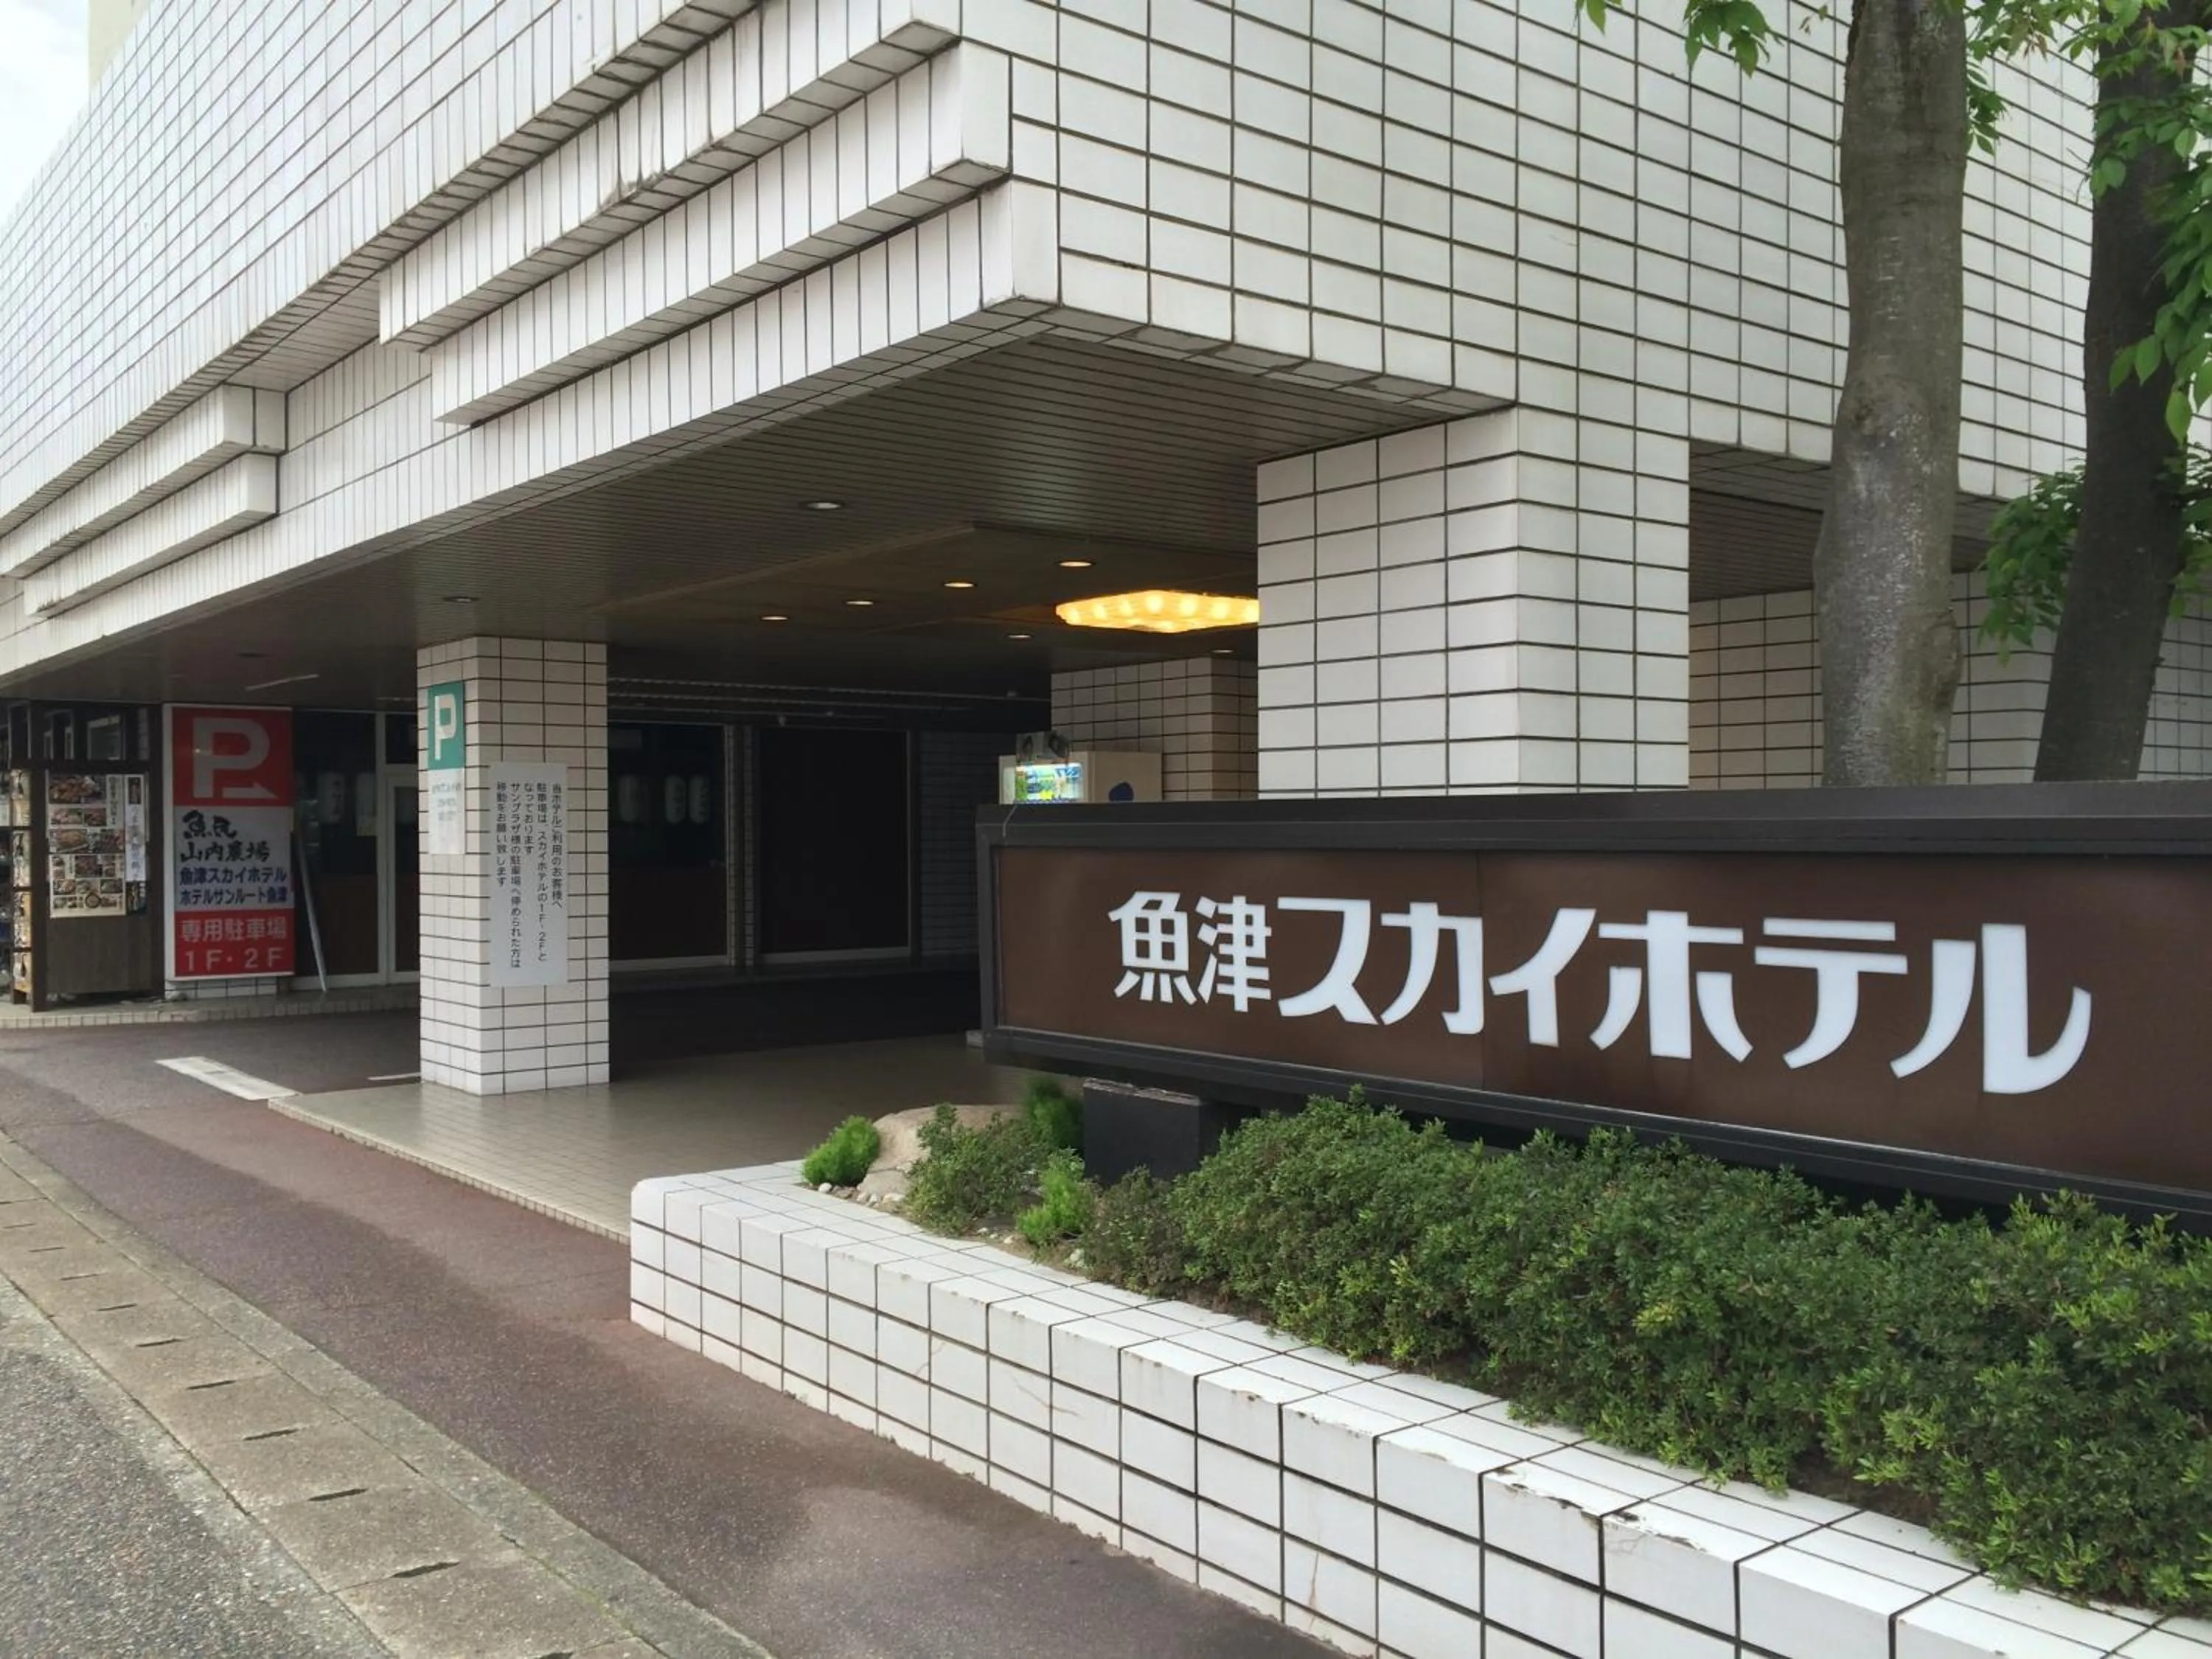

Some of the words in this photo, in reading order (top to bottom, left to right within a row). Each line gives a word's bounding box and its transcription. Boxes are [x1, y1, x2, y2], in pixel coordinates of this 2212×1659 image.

[434, 693, 456, 761] P
[193, 718, 270, 799] P
[183, 810, 237, 838] 魚民
[181, 840, 271, 862] 山内農場
[180, 867, 287, 886] 魚津スカイホテル
[180, 886, 288, 905] ホテルサンルート魚津
[181, 917, 287, 942] 専用駐車場
[1107, 891, 2092, 1094] 魚津スカイホテル
